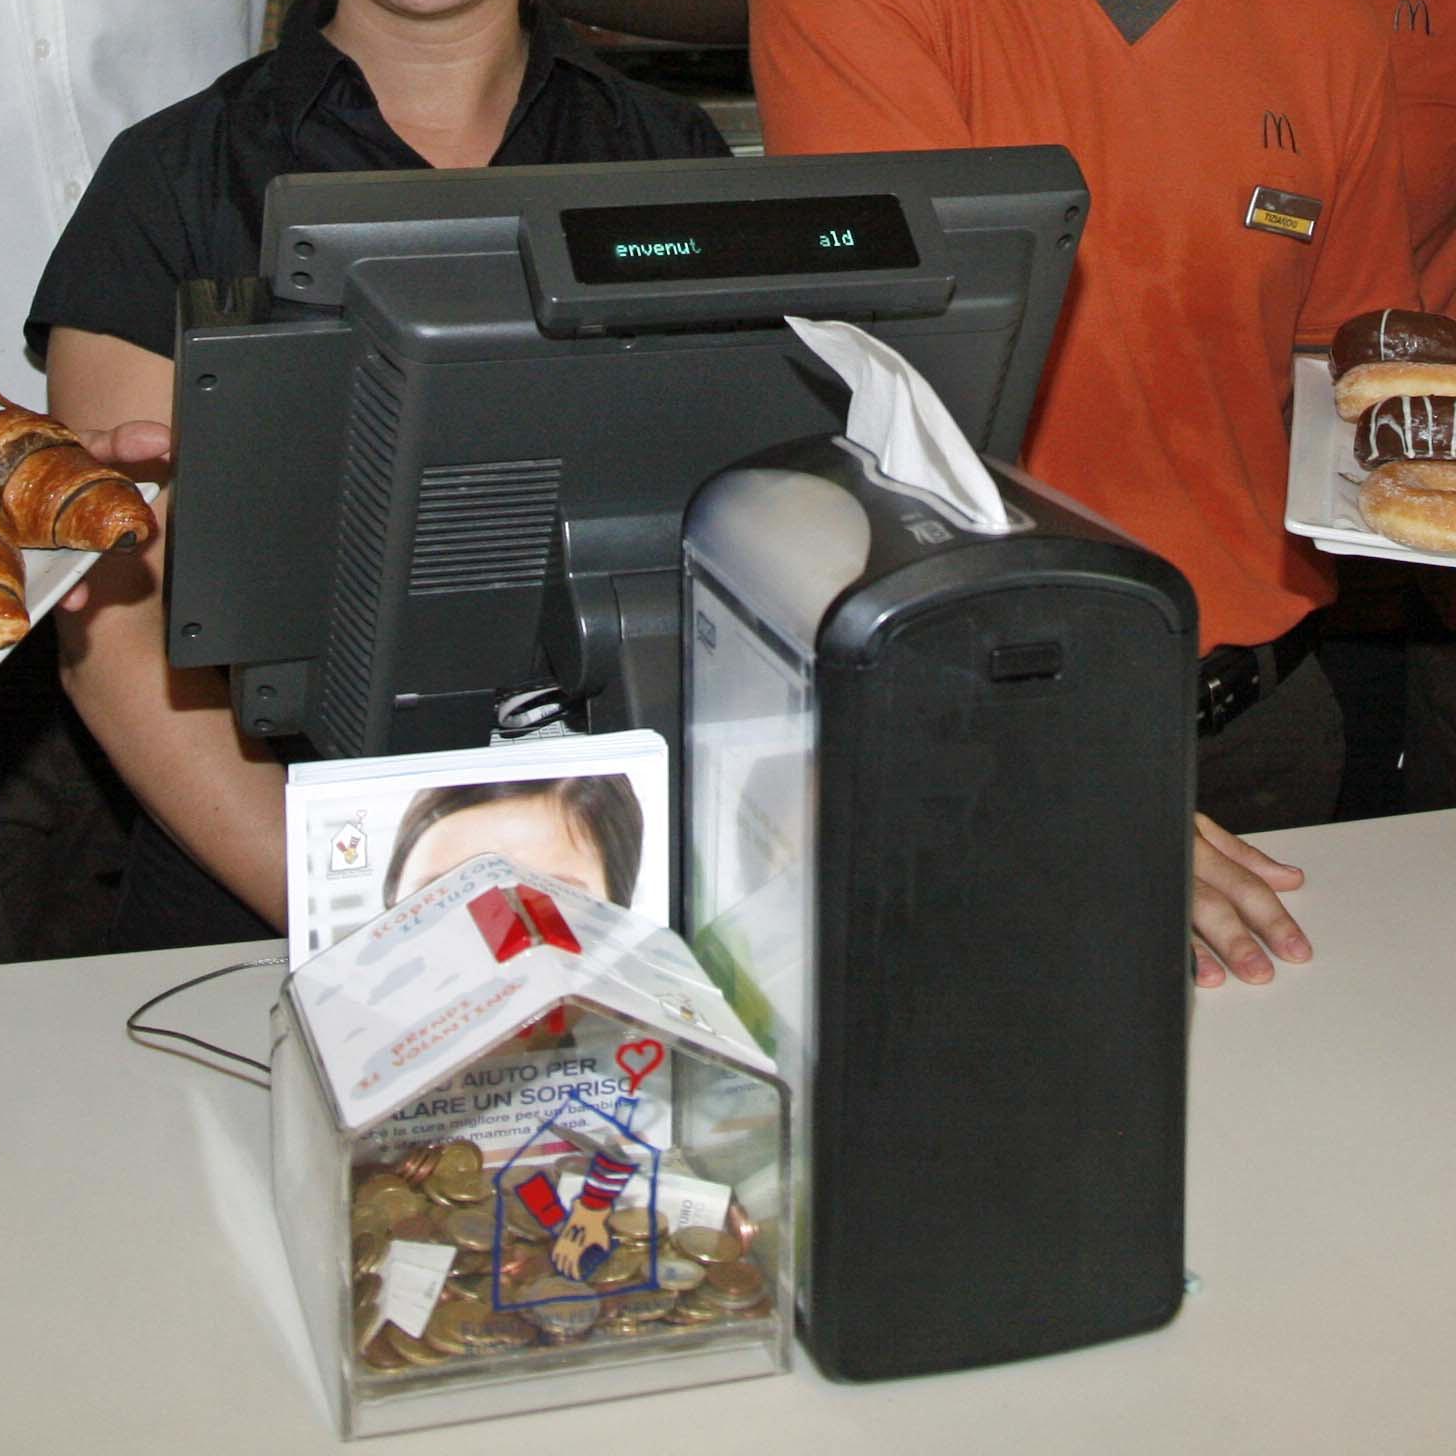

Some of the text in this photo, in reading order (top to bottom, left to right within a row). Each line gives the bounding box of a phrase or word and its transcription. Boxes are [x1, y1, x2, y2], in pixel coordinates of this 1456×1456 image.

[463, 1064, 538, 1090] AIUTO
[545, 1057, 598, 1079] PER
[473, 1091, 513, 1111] UN
